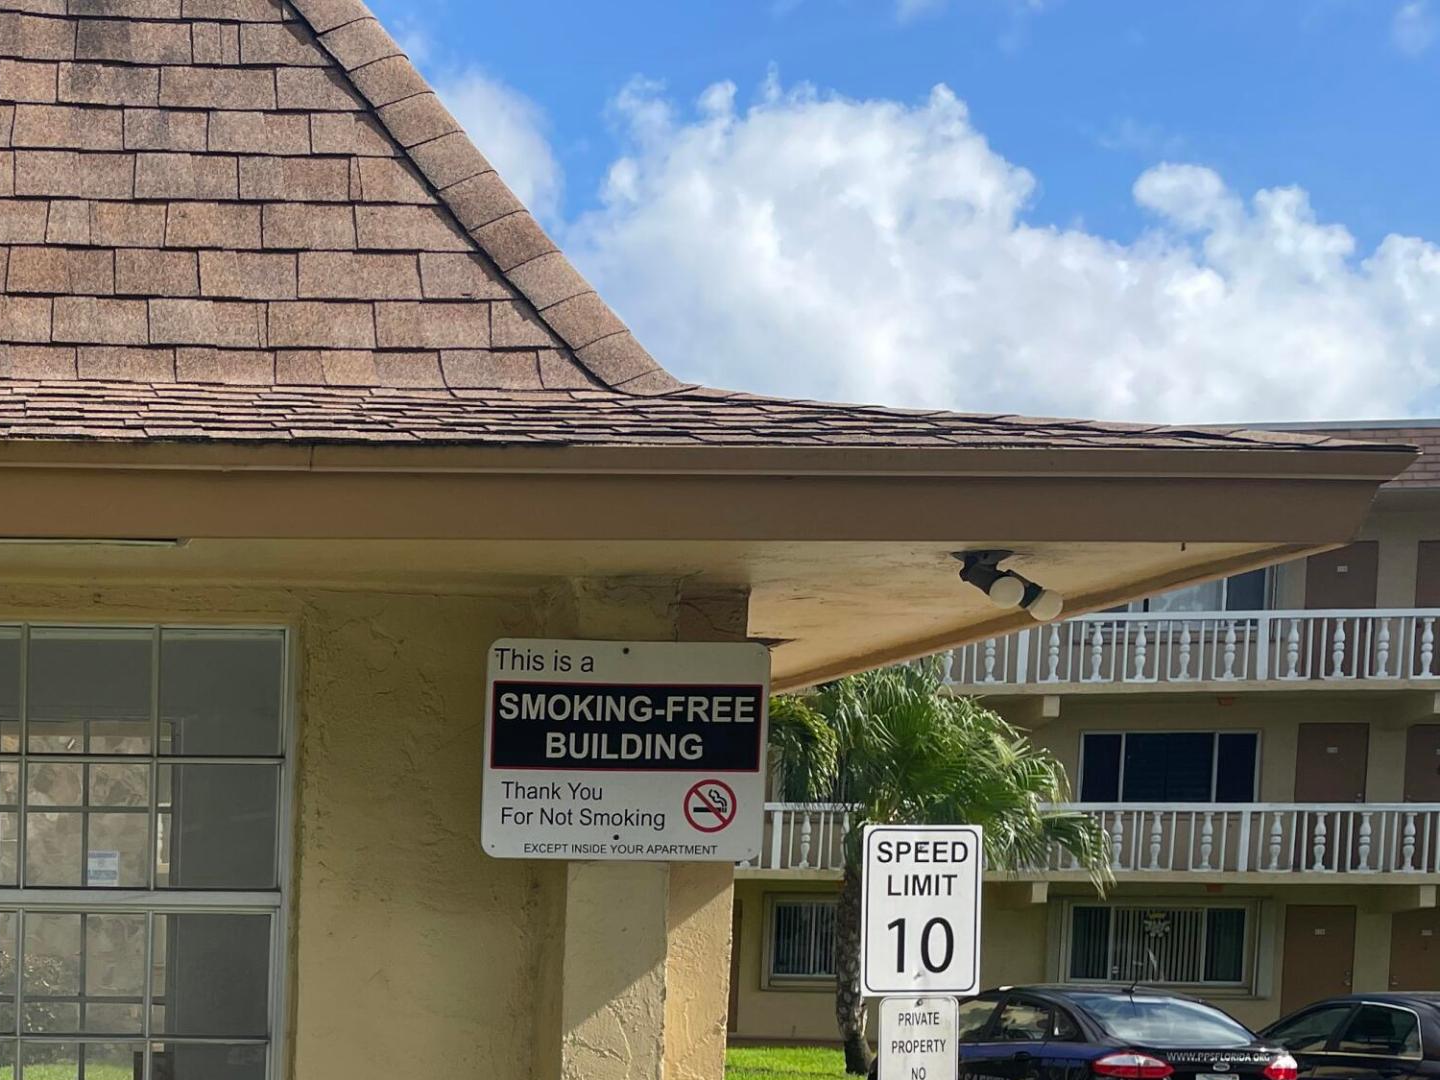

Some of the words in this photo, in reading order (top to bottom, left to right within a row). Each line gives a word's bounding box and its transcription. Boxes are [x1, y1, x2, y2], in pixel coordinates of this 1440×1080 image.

[494, 648, 544, 672] This
[553, 650, 571, 672] is
[580, 655, 594, 672] a
[498, 692, 756, 723] SMOKING-FREE
[545, 731, 704, 760] BUILDING
[501, 780, 561, 800] Thank
[567, 782, 603, 801] You
[501, 807, 534, 825] For
[539, 807, 573, 826] Not
[579, 807, 666, 831] Smoking
[523, 842, 569, 854] EXCEPT
[571, 843, 607, 854] INSIDE
[610, 844, 644, 855] YOUR
[646, 844, 719, 855] APARTMENT
[876, 840, 969, 864] SPEED
[887, 874, 958, 897] LIMIT
[887, 916, 954, 974] 10
[898, 1011, 940, 1027] PRIVATE
[891, 1039, 947, 1054] PROPERTY
[1167, 1051, 1271, 1063] WWW.PPSFLORIDAORG
[911, 1066, 927, 1080] NO
